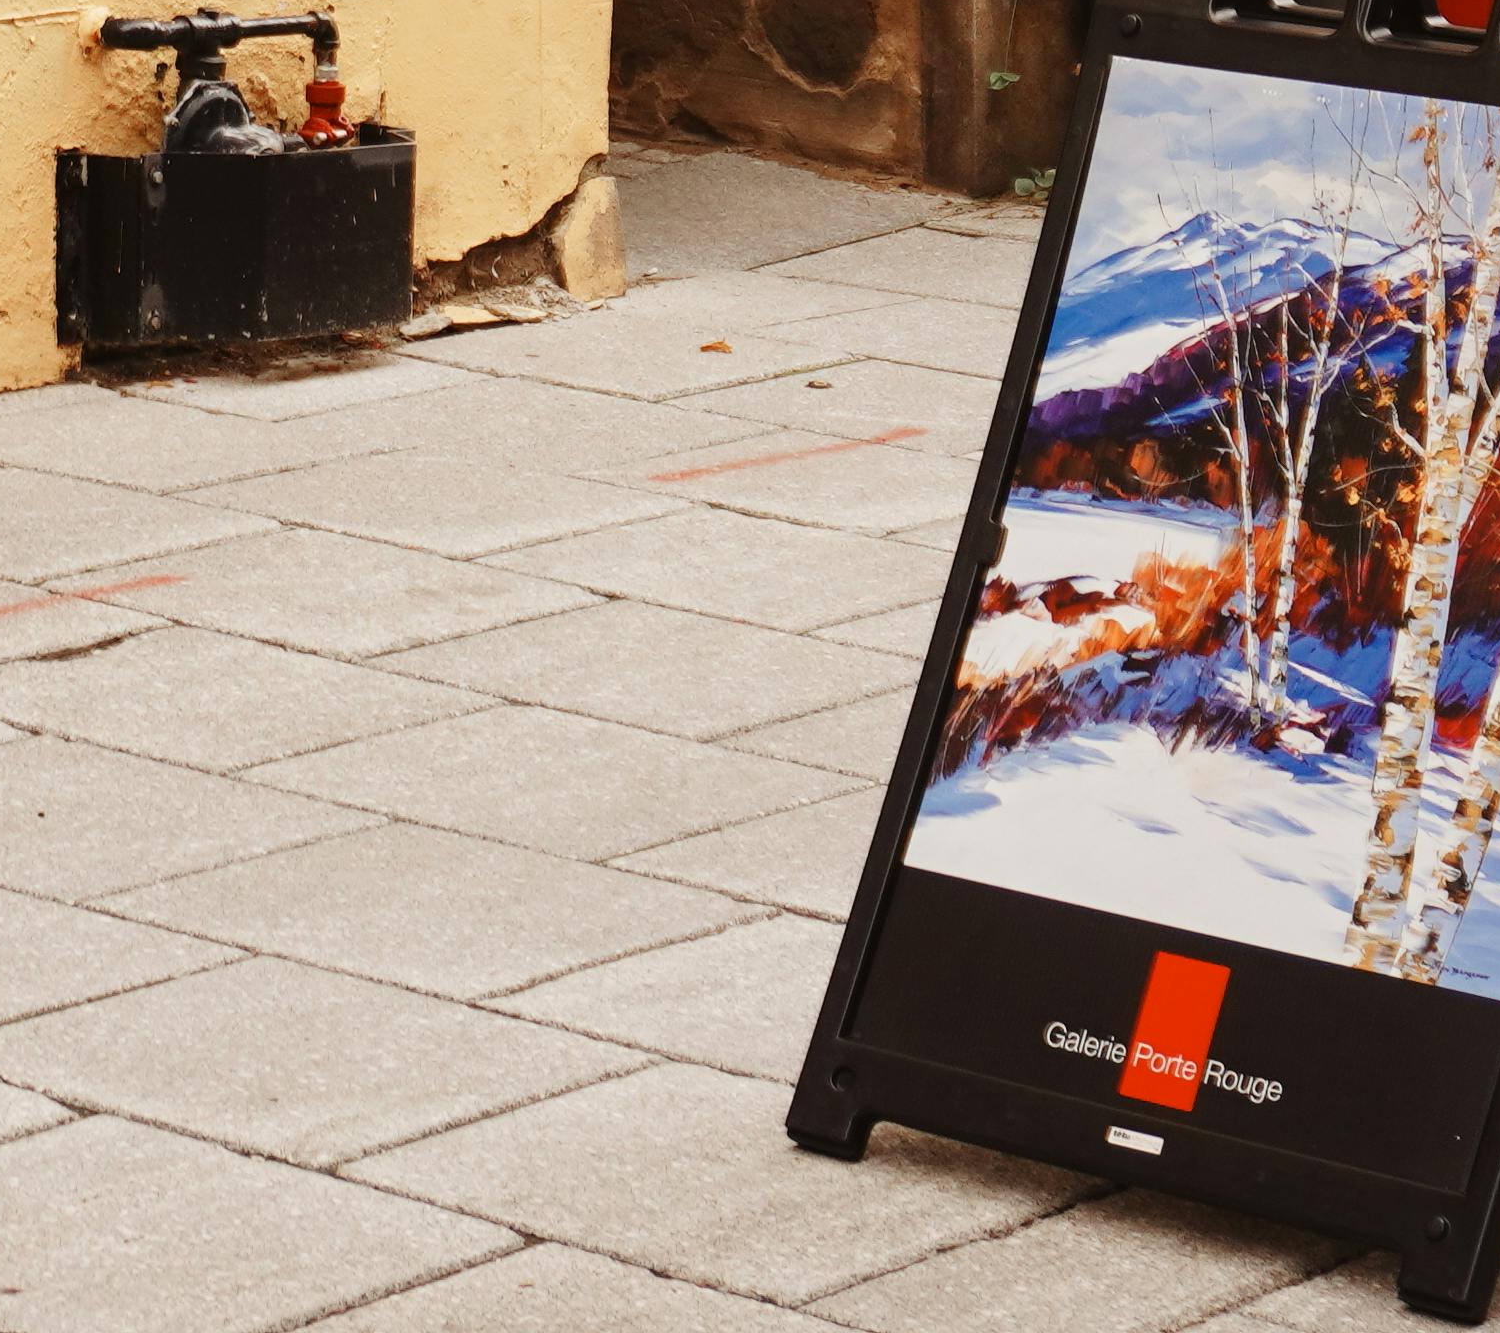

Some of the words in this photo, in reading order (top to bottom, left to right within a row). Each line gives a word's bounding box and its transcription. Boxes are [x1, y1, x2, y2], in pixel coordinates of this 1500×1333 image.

[1044, 1020, 1128, 1065] Galerie
[1132, 1041, 1198, 1082] Porte
[1203, 1059, 1284, 1105] Rouge
